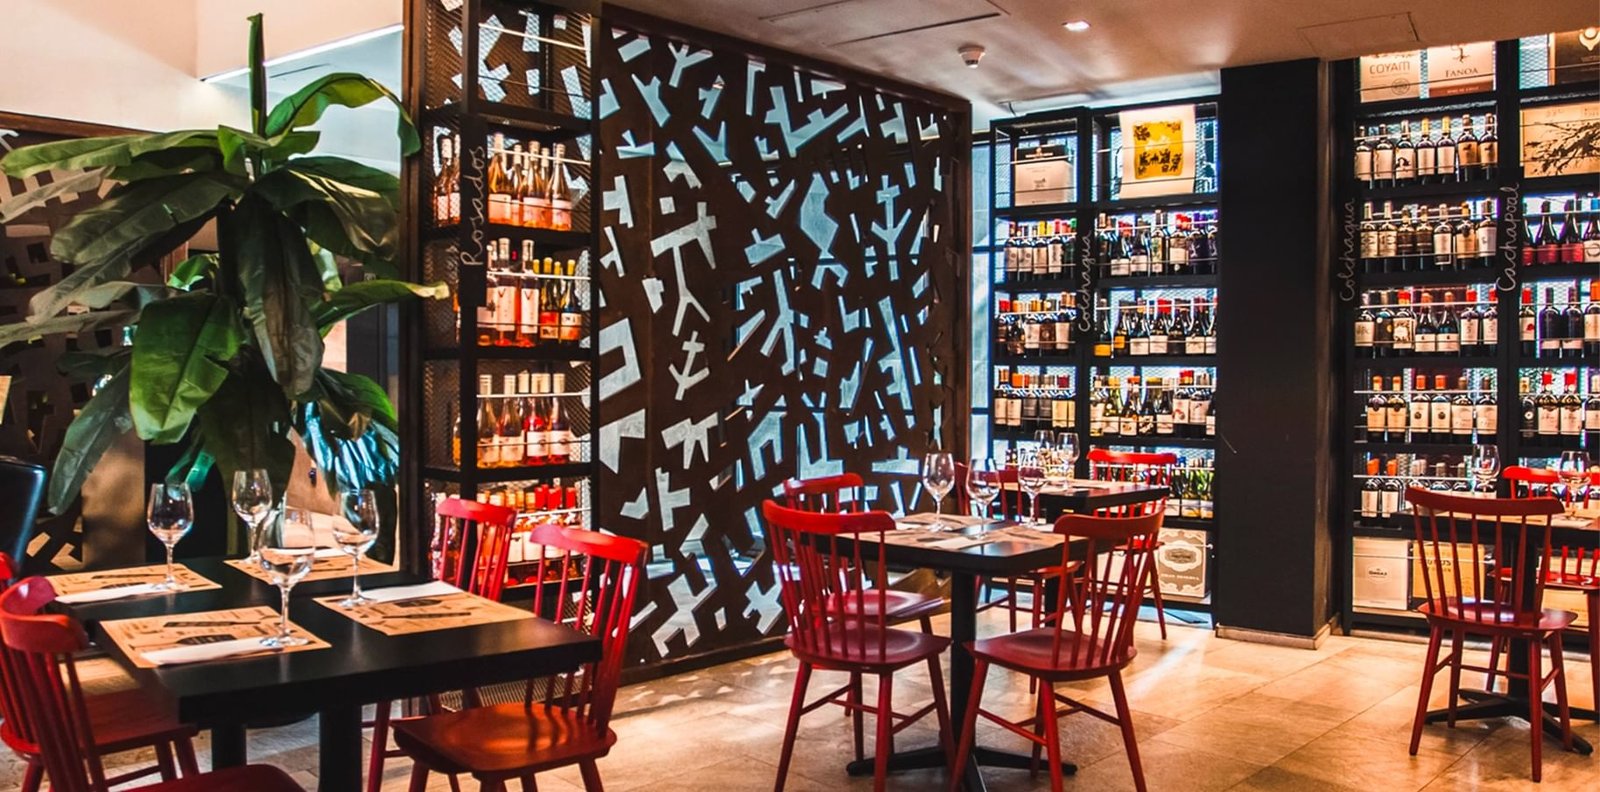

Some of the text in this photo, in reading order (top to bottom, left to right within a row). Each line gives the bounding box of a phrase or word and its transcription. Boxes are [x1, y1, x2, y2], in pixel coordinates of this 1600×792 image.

[1369, 61, 1411, 75] COYAM
[459, 145, 485, 266] Rosados
[1495, 181, 1520, 292] Cachapoal
[1077, 230, 1096, 332] Colchagua
